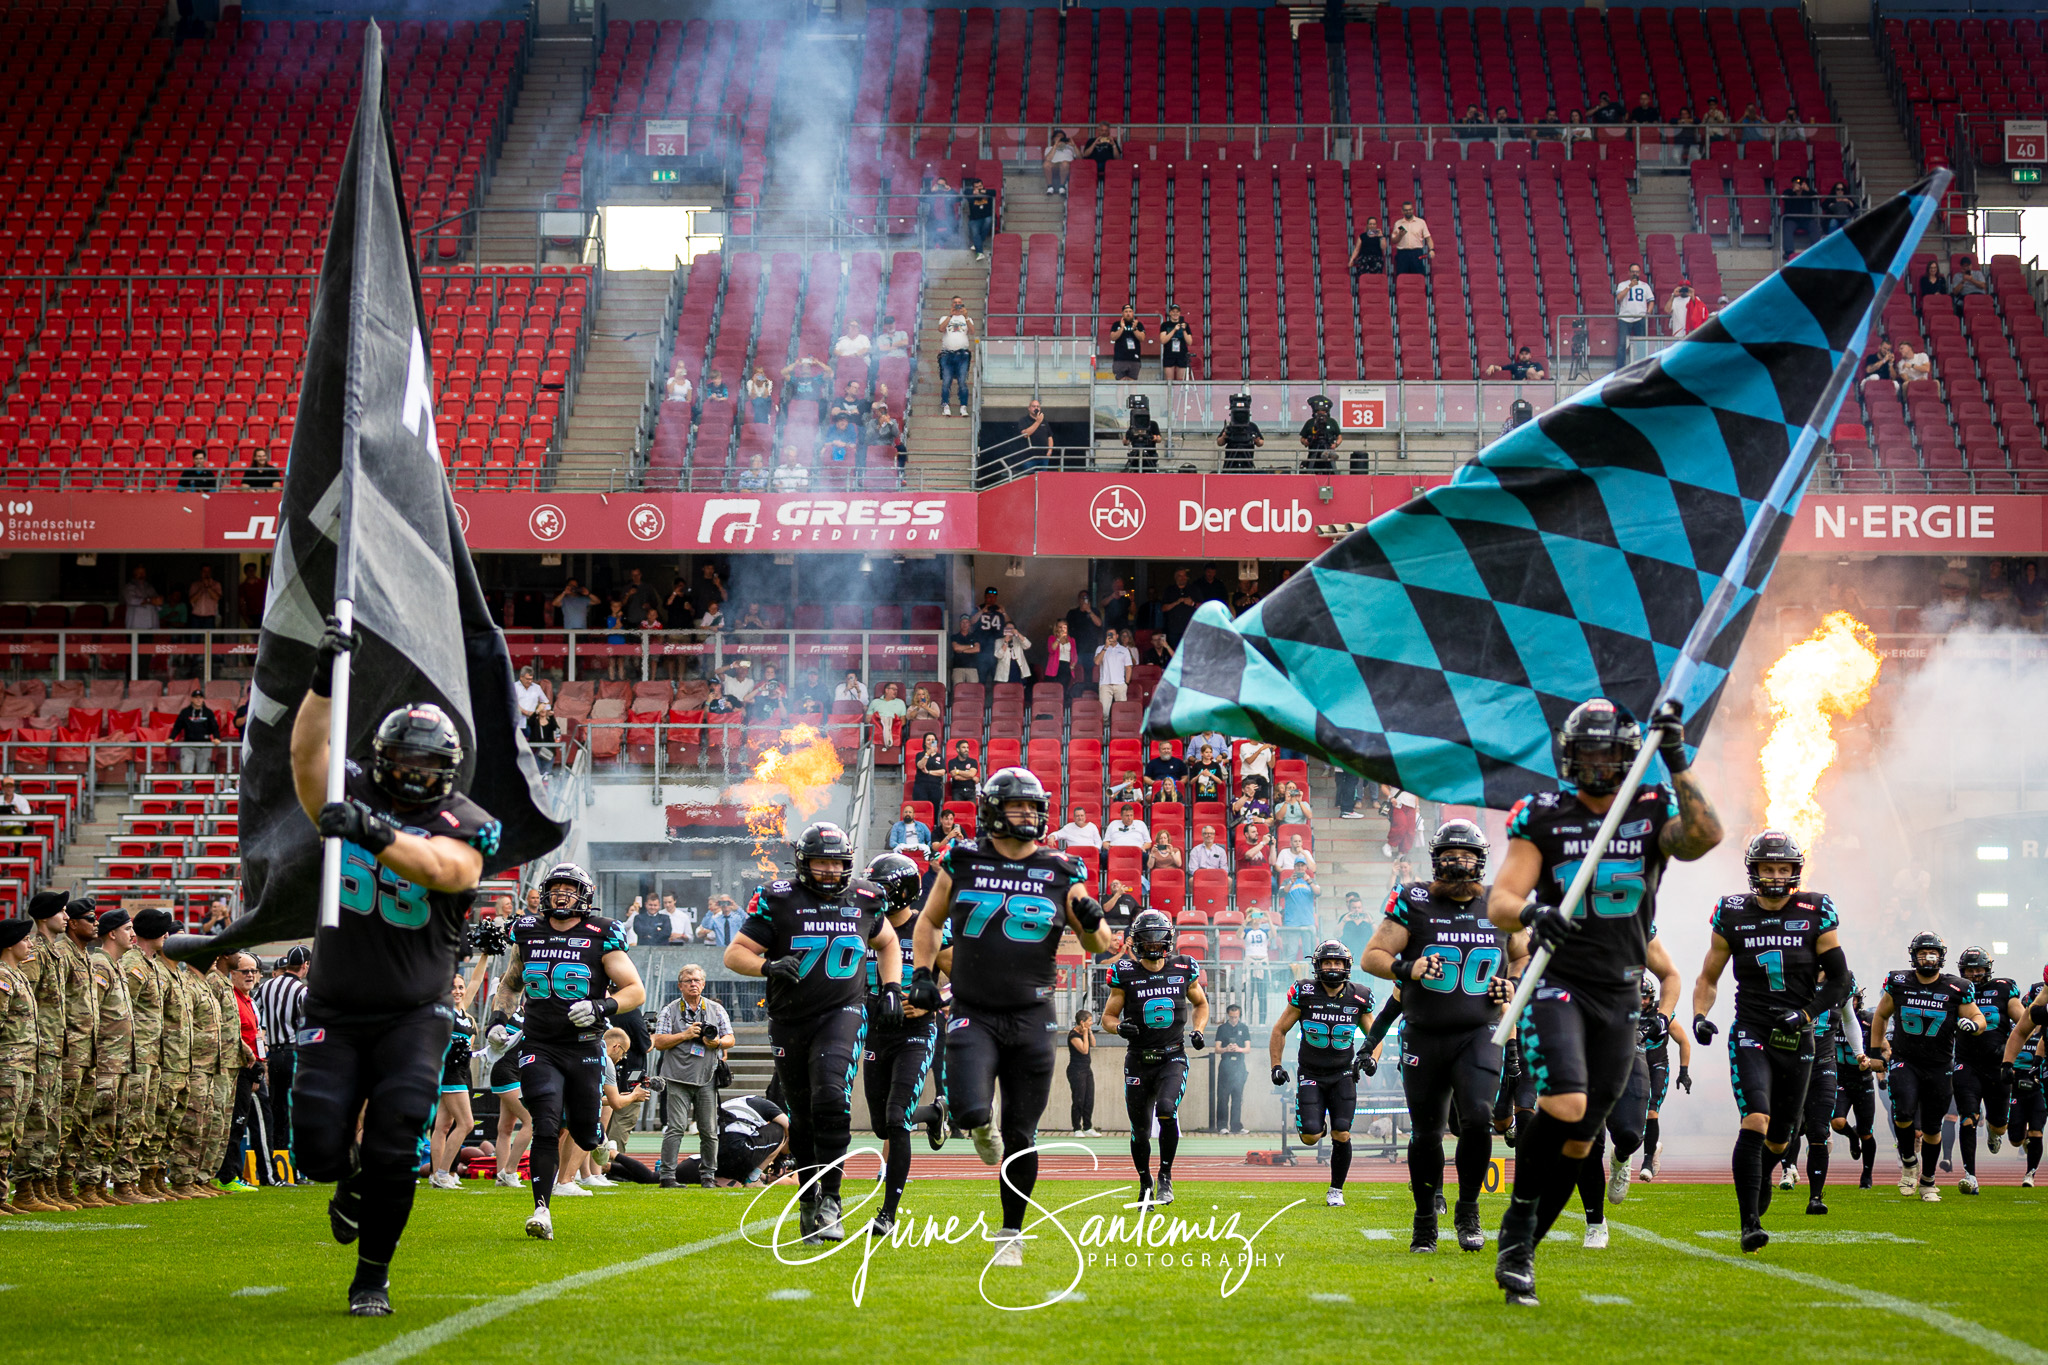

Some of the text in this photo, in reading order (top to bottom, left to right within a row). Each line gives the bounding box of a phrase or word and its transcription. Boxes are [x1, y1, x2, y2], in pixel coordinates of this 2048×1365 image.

[657, 143, 676, 156] 36
[2017, 143, 2036, 157] 40
[1628, 288, 1644, 302] 18
[1352, 409, 1374, 425] 38
[1111, 489, 1124, 508] 1.
[776, 500, 946, 526] GRESS
[1096, 508, 1139, 528] FCN
[1179, 499, 1313, 533] Der Club
[9, 518, 96, 529] Brandschutz
[9, 530, 85, 541] Sichelstiel
[771, 528, 941, 541] SPEDITION
[981, 615, 1001, 630] 54
[887, 866, 914, 881] RAVENS
[974, 877, 1044, 894] MUNICH
[956, 889, 1058, 943] 78
[804, 921, 857, 932] MUNICH
[1251, 934, 1263, 944] 19
[1437, 932, 1495, 944] MUNICH
[1744, 936, 1803, 948] MUNICH
[531, 949, 581, 960] MUNICH
[790, 935, 866, 980] 70
[1421, 944, 1502, 995] 60
[1756, 949, 1786, 992] 1
[522, 961, 592, 1000] 56
[1137, 986, 1180, 998] MUNICH
[1907, 998, 1943, 1009] MUNICH
[1143, 997, 1176, 1029] 6
[1312, 1012, 1352, 1022] MUNICH
[1900, 1005, 1948, 1037] 57
